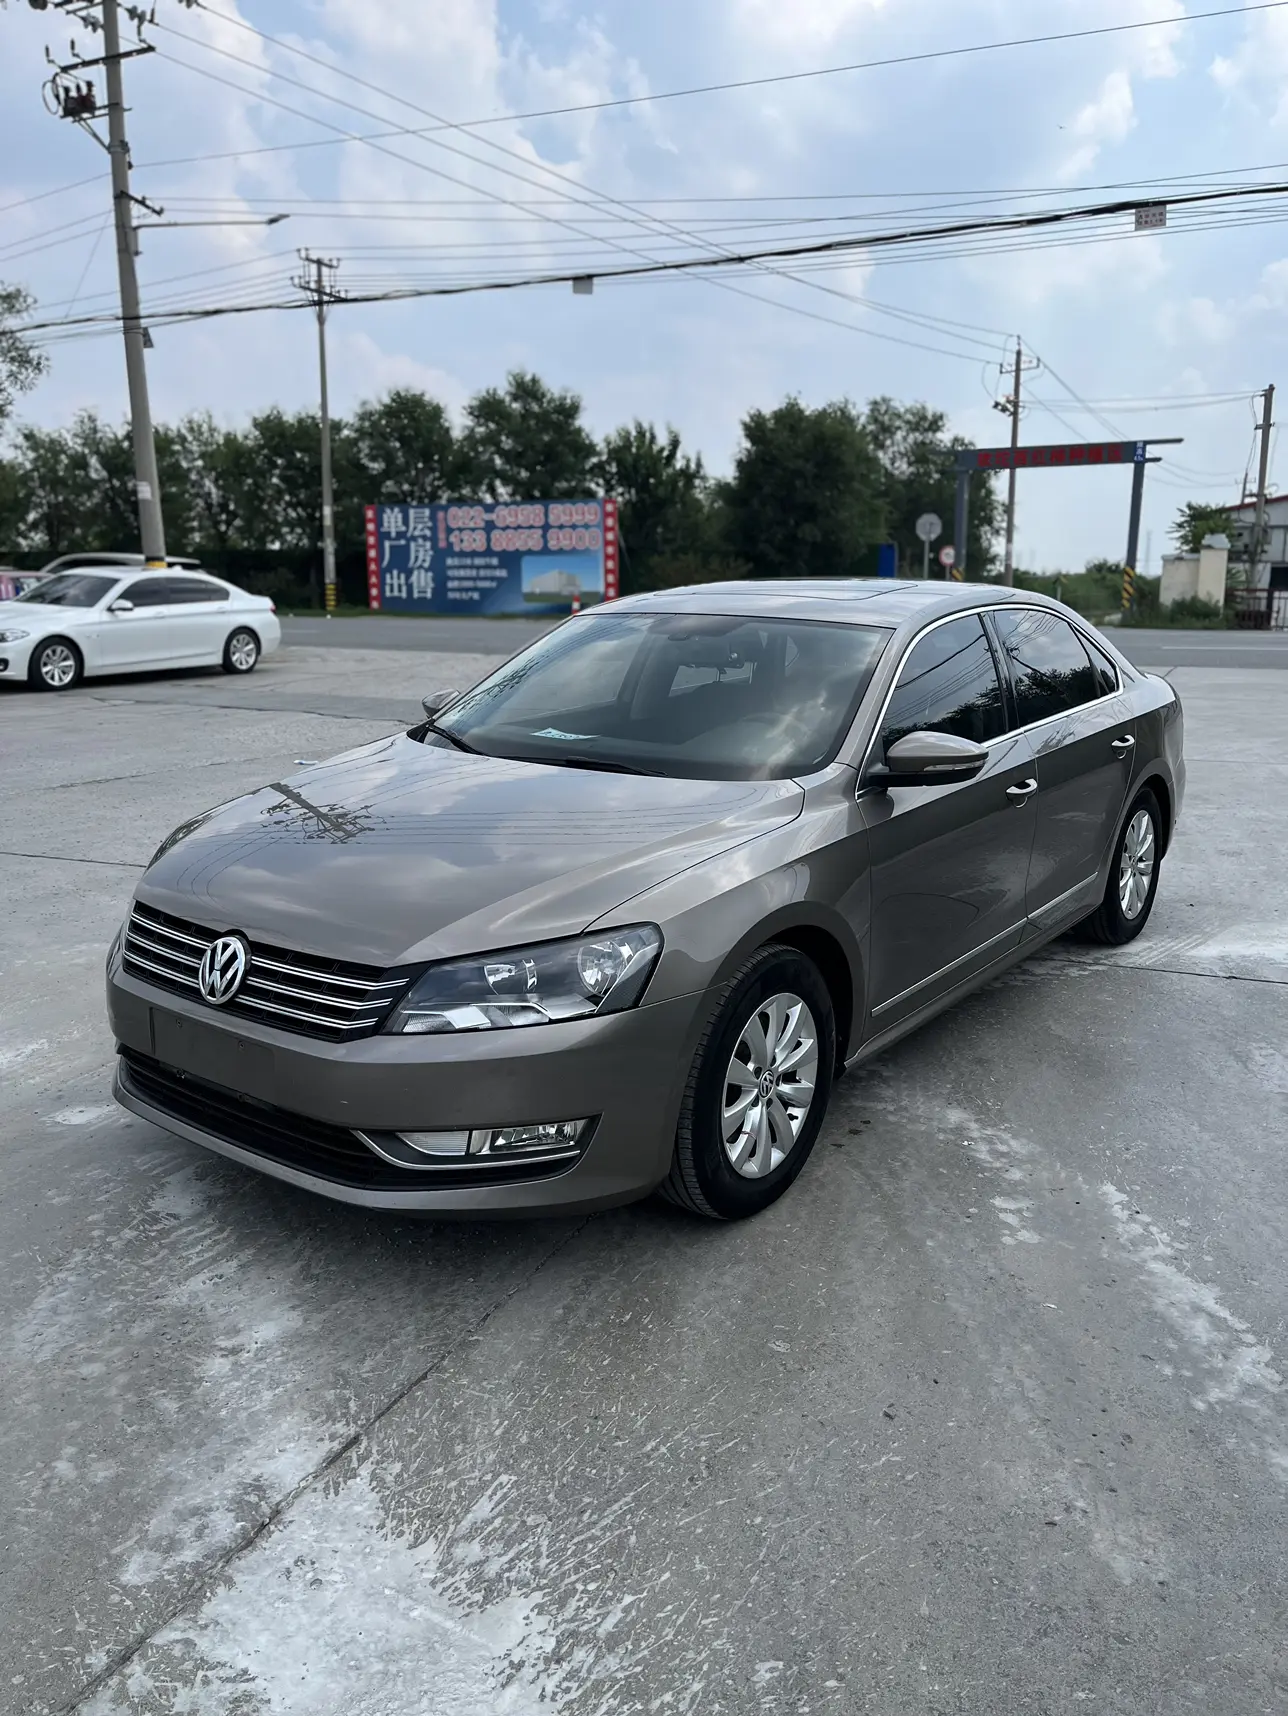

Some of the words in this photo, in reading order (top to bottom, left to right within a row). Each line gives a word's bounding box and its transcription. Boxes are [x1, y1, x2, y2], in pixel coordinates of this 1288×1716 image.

[381, 507, 433, 538] 单层
[447, 504, 545, 529] 022-6958
[548, 502, 601, 526] 5999
[382, 538, 434, 569] 厂房
[448, 529, 487, 552] 133
[547, 527, 601, 550] 9900
[384, 569, 435, 600] 出售
